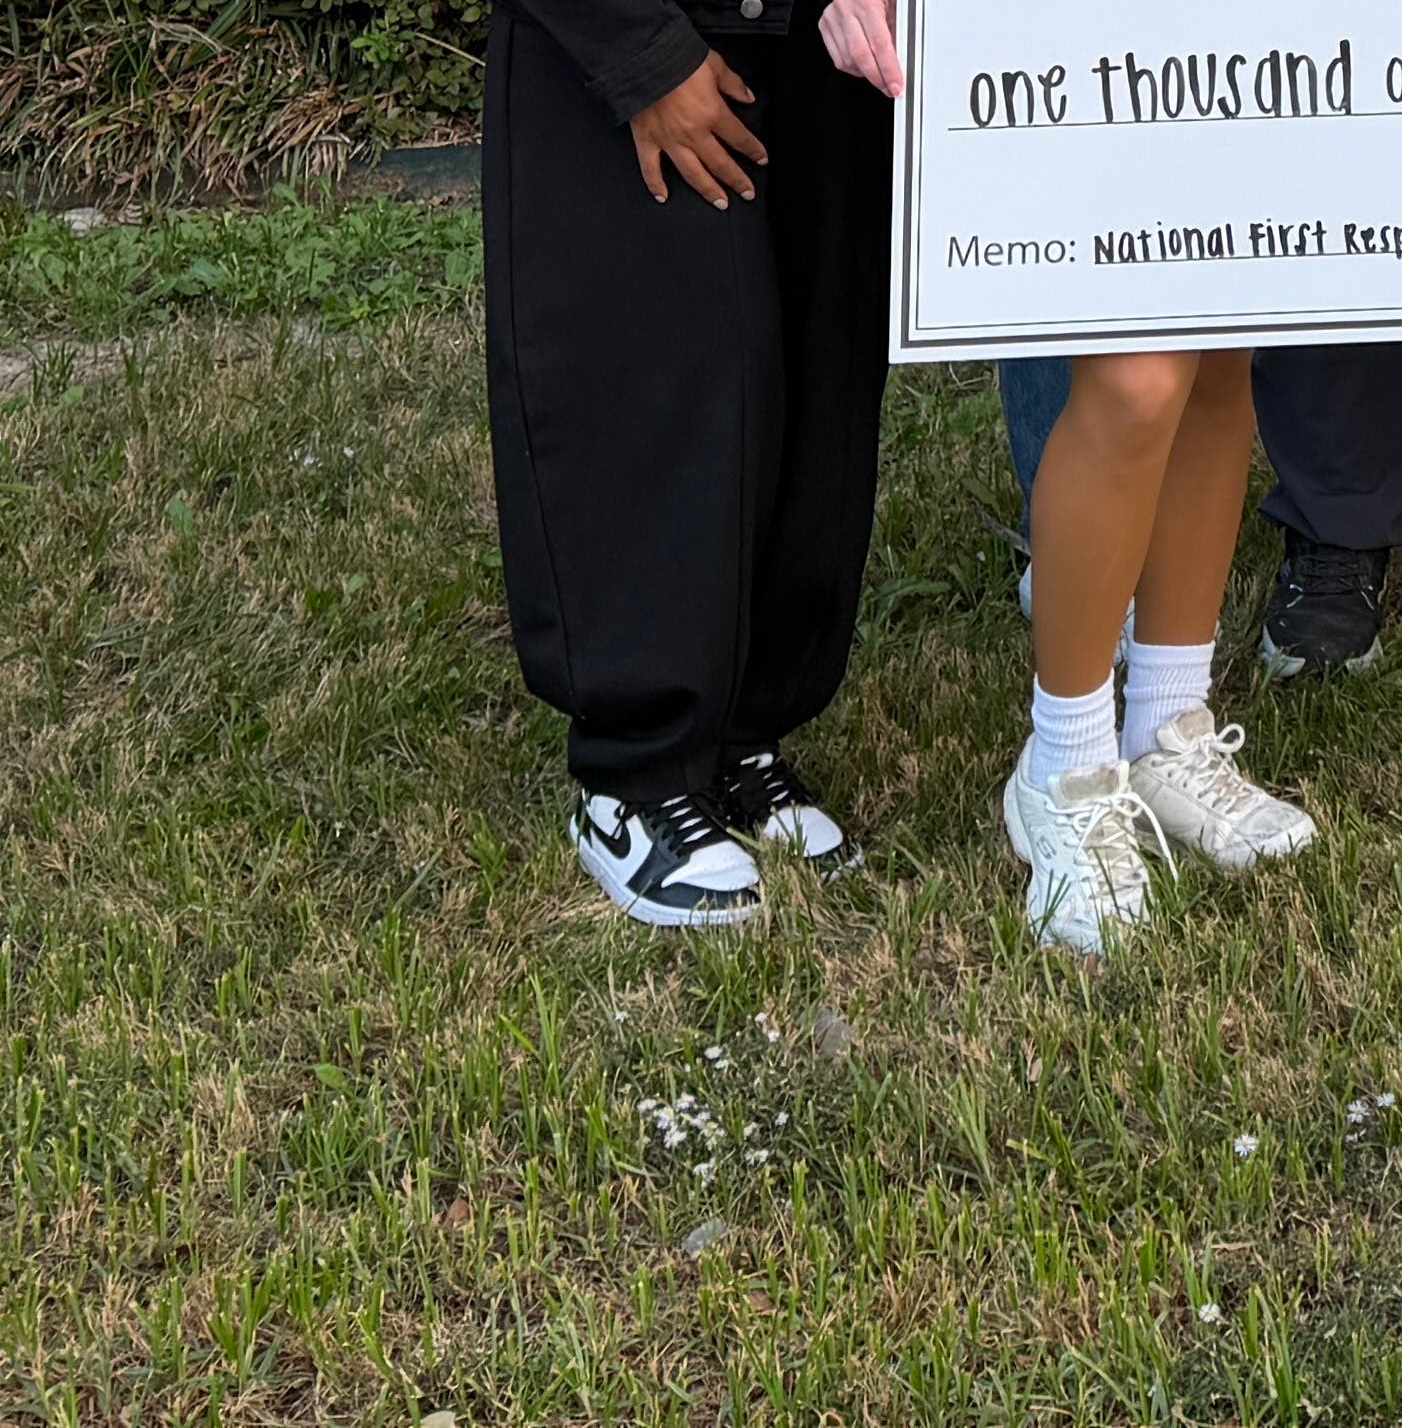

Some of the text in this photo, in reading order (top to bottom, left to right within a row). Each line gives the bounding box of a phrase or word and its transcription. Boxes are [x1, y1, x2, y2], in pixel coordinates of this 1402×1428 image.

[969, 61, 1068, 129] one
[1091, 38, 1352, 123] thousand
[947, 235, 1077, 268] Memo:
